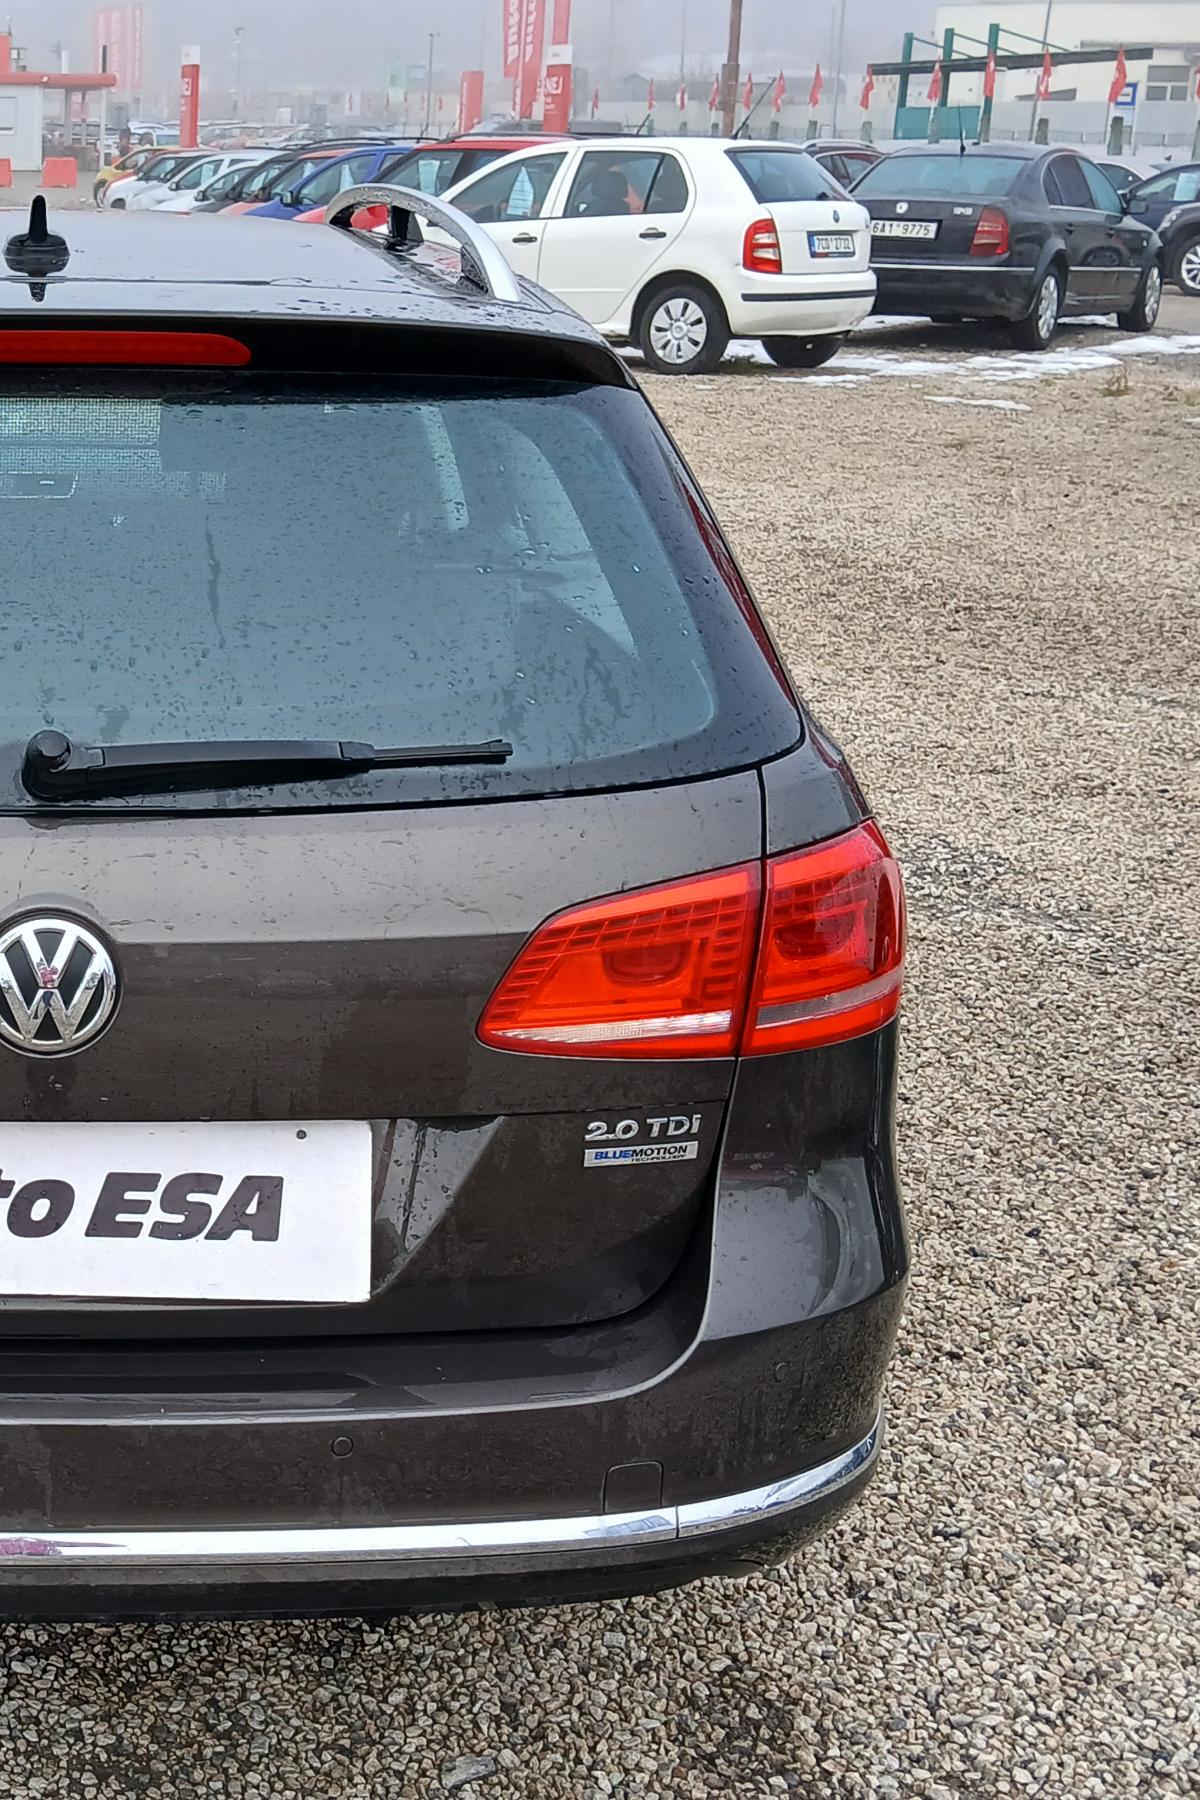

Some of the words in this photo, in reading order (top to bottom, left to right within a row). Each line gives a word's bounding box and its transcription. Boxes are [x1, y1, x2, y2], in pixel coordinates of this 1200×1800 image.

[872, 222, 894, 235] 6A1
[902, 223, 931, 237] 9775
[646, 1114, 702, 1137] TDI
[593, 1145, 687, 1161] BLUEMOTION
[84, 1171, 284, 1242] ESA
